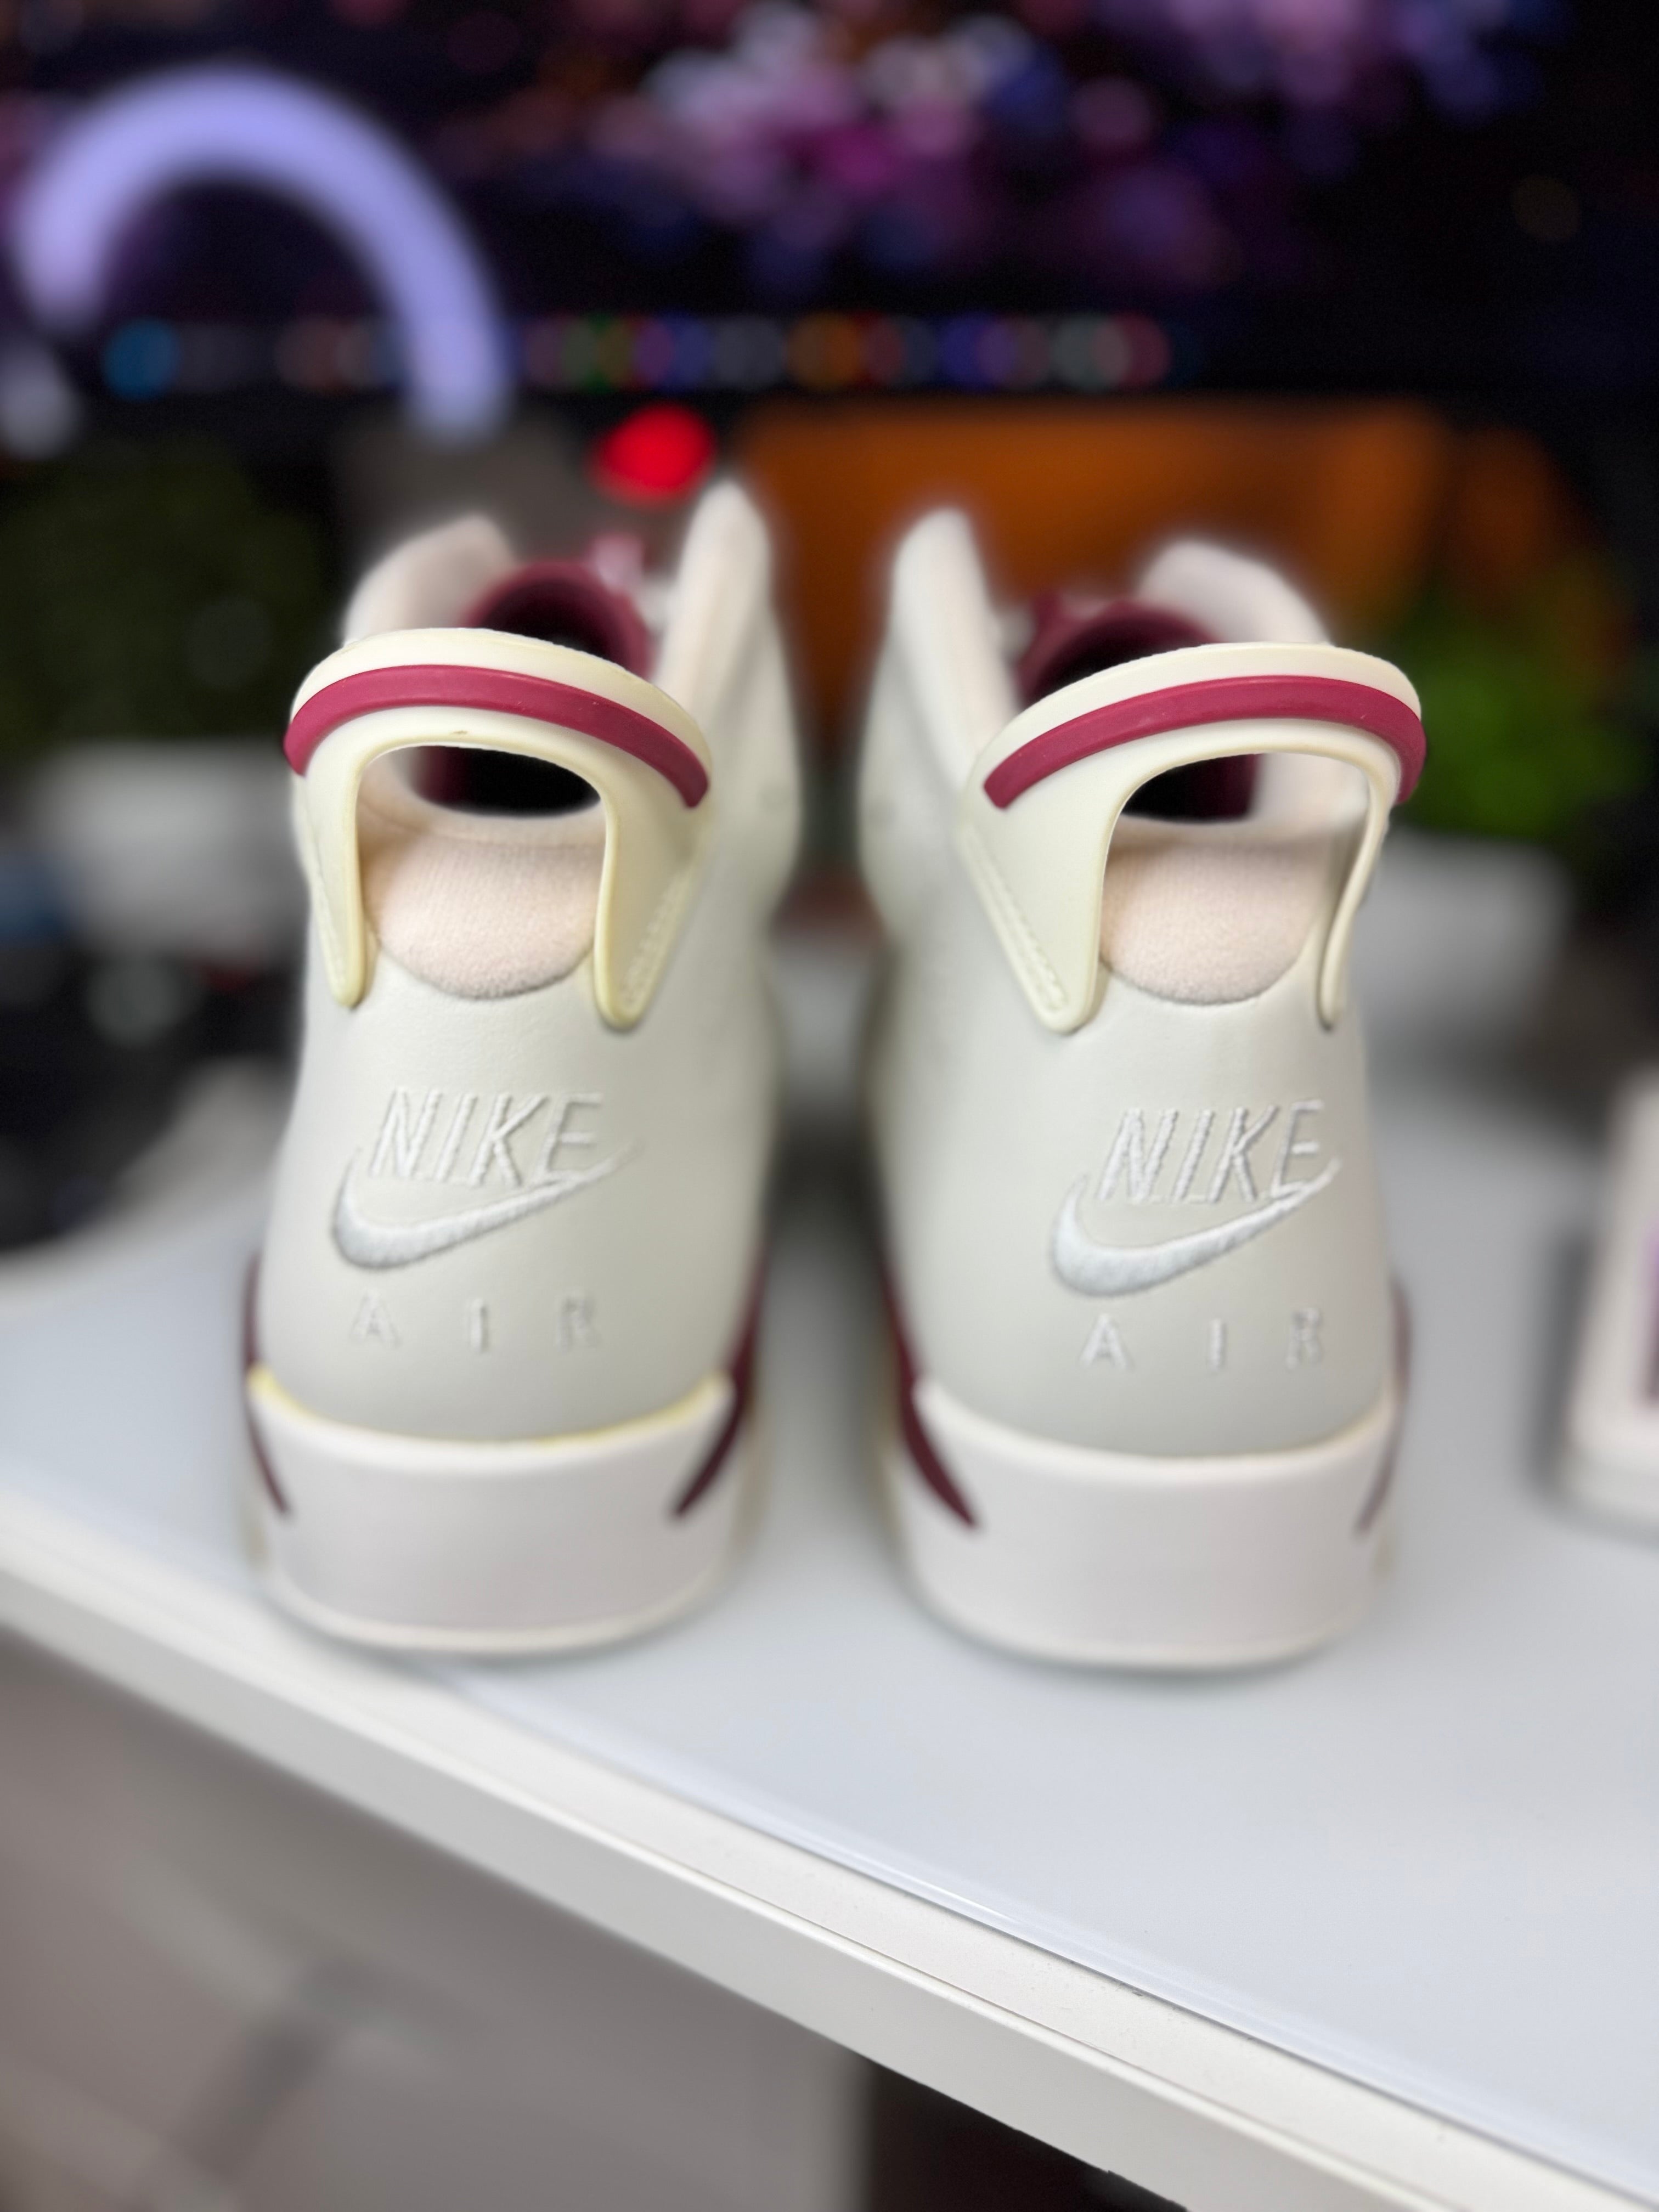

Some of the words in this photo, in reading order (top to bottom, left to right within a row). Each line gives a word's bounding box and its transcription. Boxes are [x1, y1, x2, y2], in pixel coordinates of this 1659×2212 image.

[368, 1088, 603, 1187] NIKE
[1096, 1098, 1324, 1204] NIKE
[352, 1291, 601, 1353] AIR
[1079, 1310, 1323, 1370] AIR
